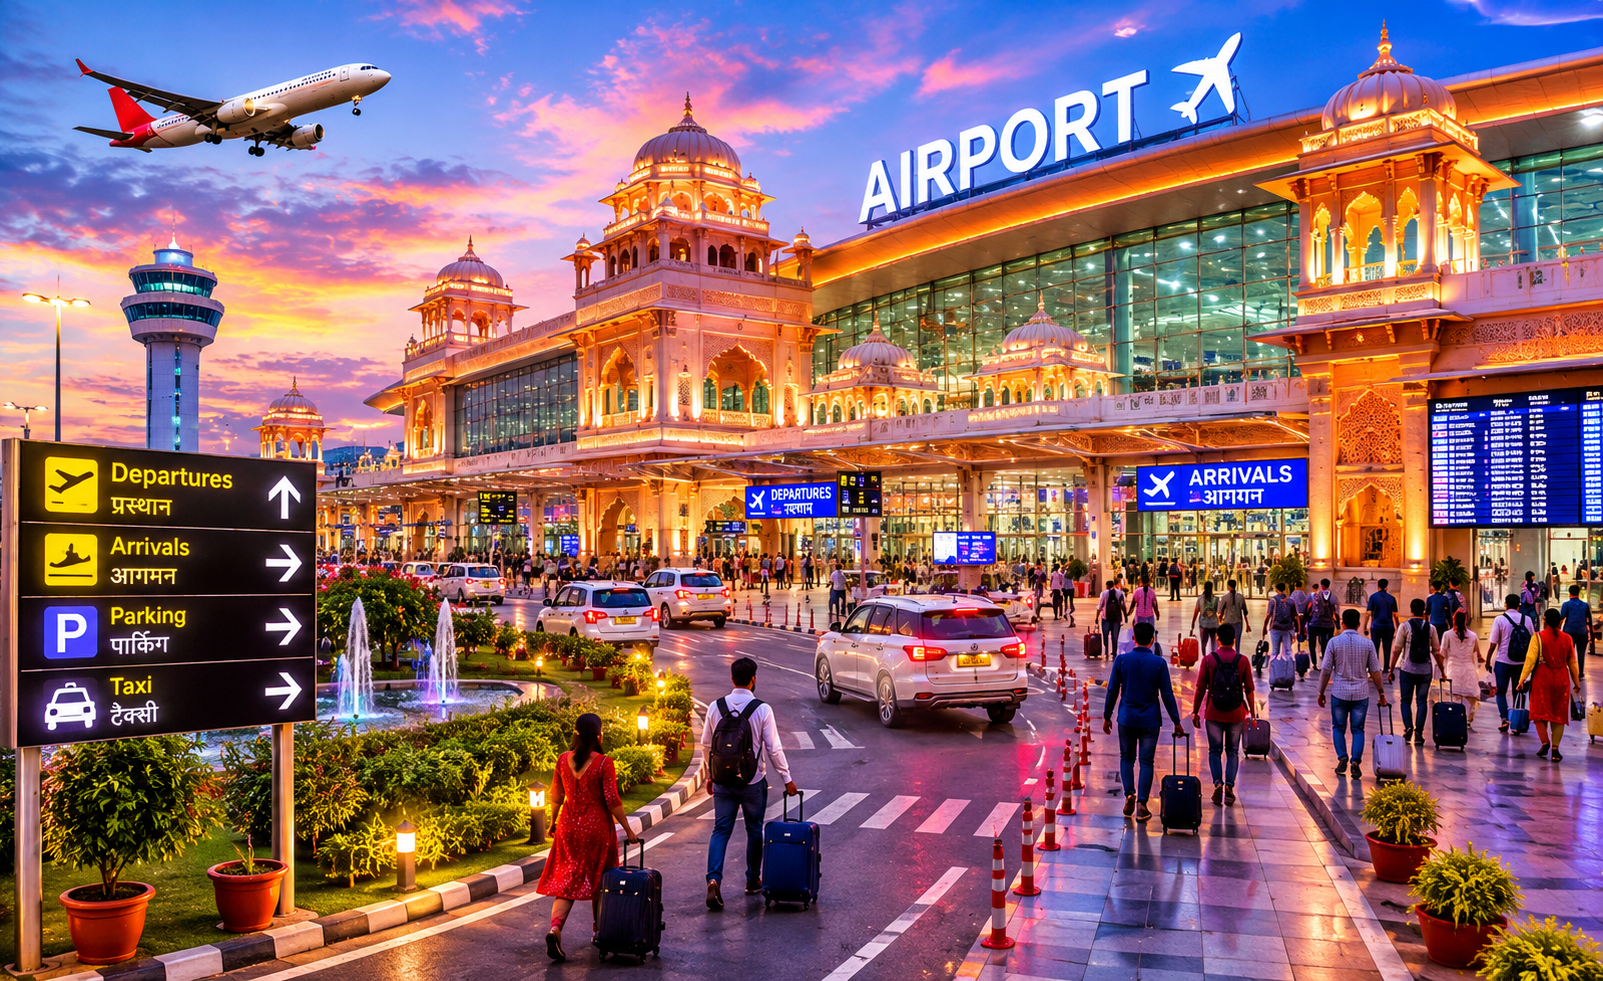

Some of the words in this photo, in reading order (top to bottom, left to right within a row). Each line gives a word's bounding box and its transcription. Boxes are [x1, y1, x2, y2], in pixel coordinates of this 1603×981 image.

[859, 69, 1148, 224] AIRPORT
[111, 462, 233, 489] Departures
[1189, 465, 1293, 487] ARRIVALS
[771, 486, 832, 501] DEPARTURES
[110, 496, 173, 517] प्रस्थान
[110, 536, 190, 557] Arrivals
[110, 567, 178, 585] आगमन
[110, 606, 187, 628] Parking
[57, 613, 88, 654] P
[110, 675, 152, 696] Taxi
[110, 699, 160, 727] टैक्सी
